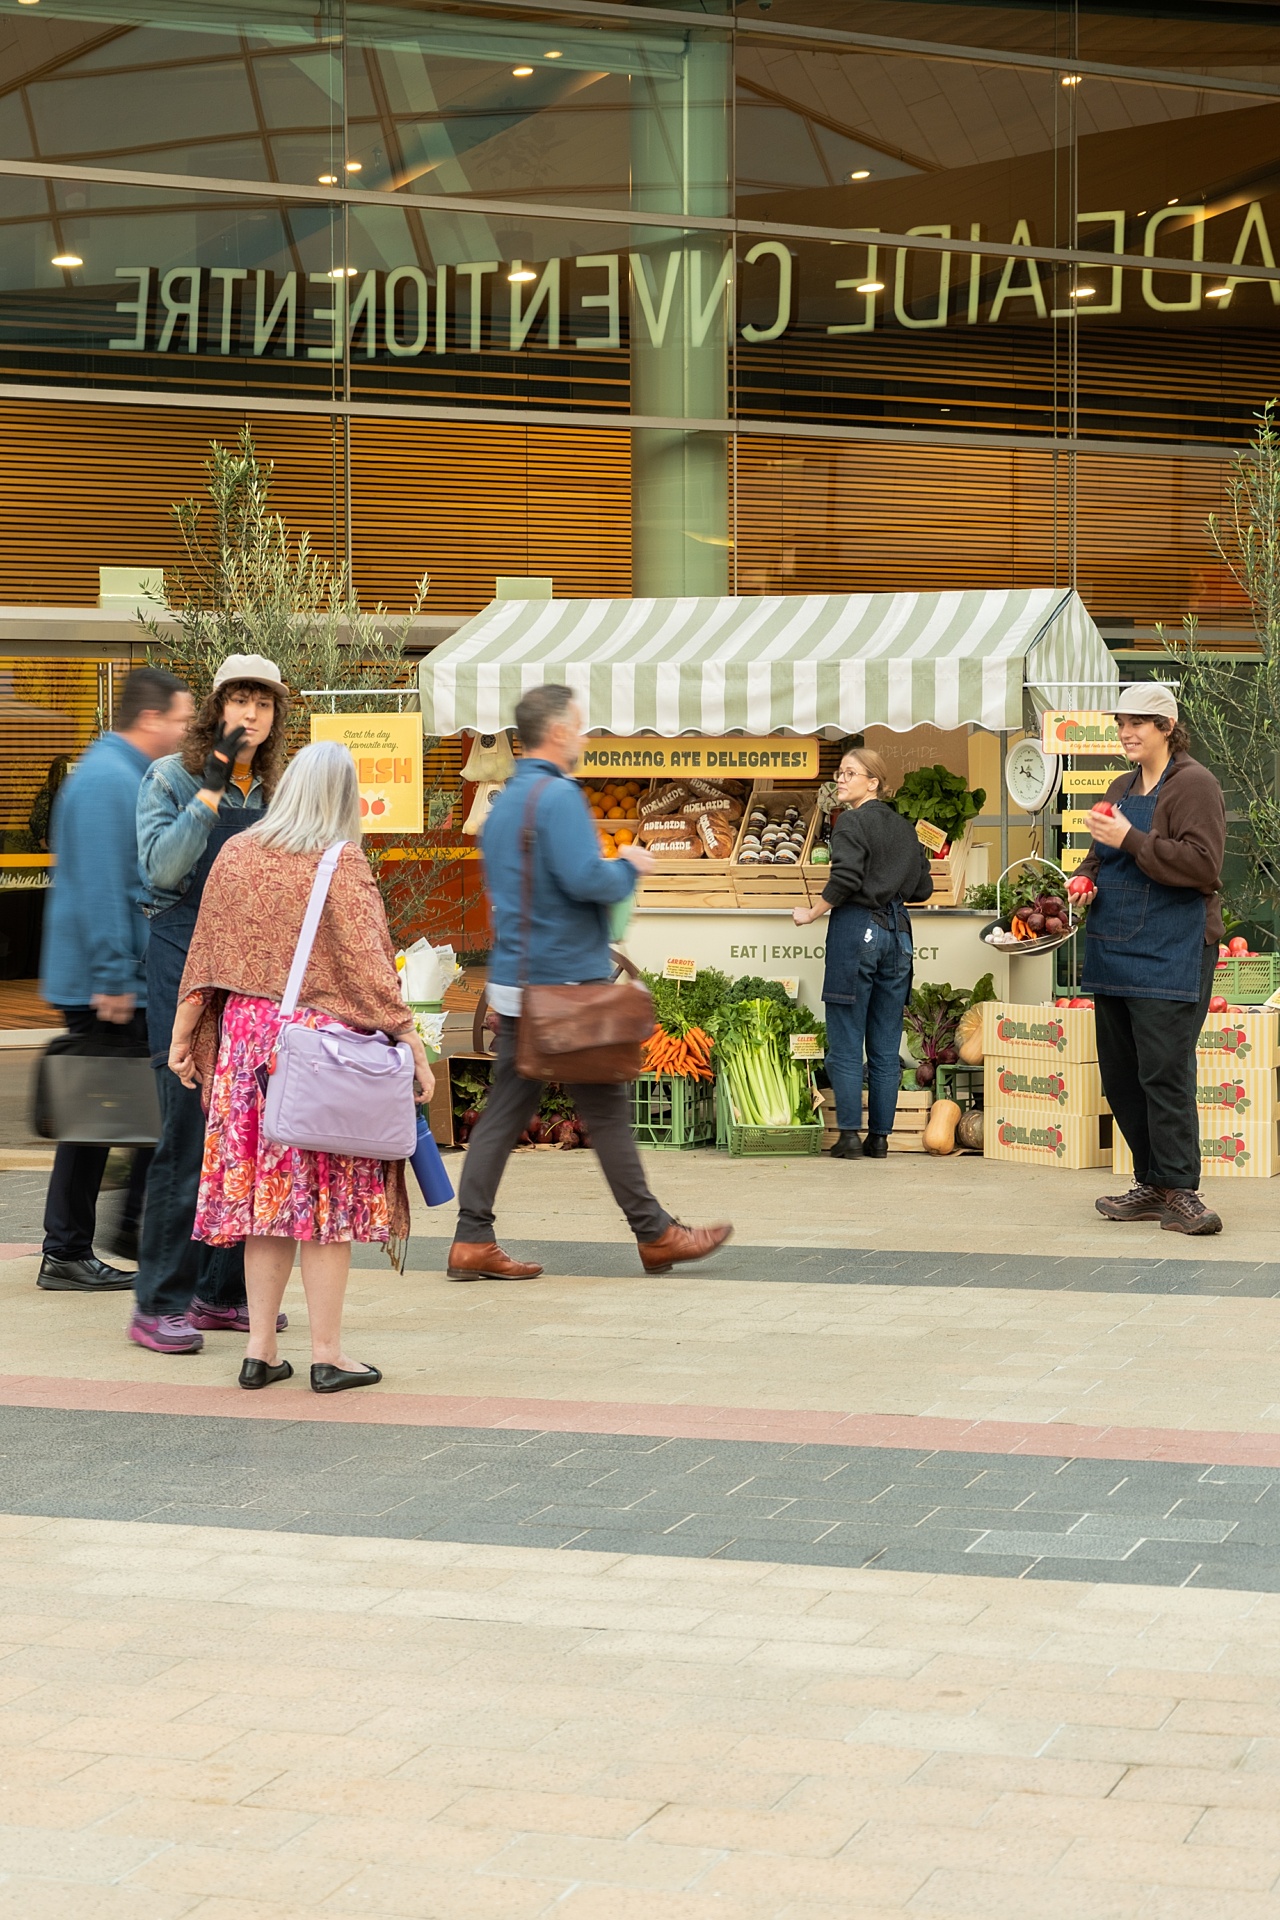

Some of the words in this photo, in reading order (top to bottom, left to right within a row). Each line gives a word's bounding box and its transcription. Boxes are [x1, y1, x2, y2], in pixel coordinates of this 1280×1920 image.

[343, 730, 362, 738] Start
[364, 730, 375, 738] the
[377, 730, 390, 742] day
[1065, 726, 1118, 741] ADELA
[670, 751, 700, 767] ATE
[706, 751, 808, 767] DELEGATES!
[355, 758, 412, 783] ESH
[641, 788, 685, 816] ADELAIDE
[683, 799, 730, 813] ADELAIDE
[643, 821, 686, 831] ADELAIDE
[649, 841, 691, 852] ADELAIDE
[731, 946, 757, 958] EAT
[772, 946, 826, 959] EXPLO
[667, 958, 695, 966] CARROTS
[1002, 1021, 1059, 1042] ADELAIDE
[1004, 1074, 1060, 1095] ADELAIDE
[1003, 1126, 1058, 1147] ADELAIDE
